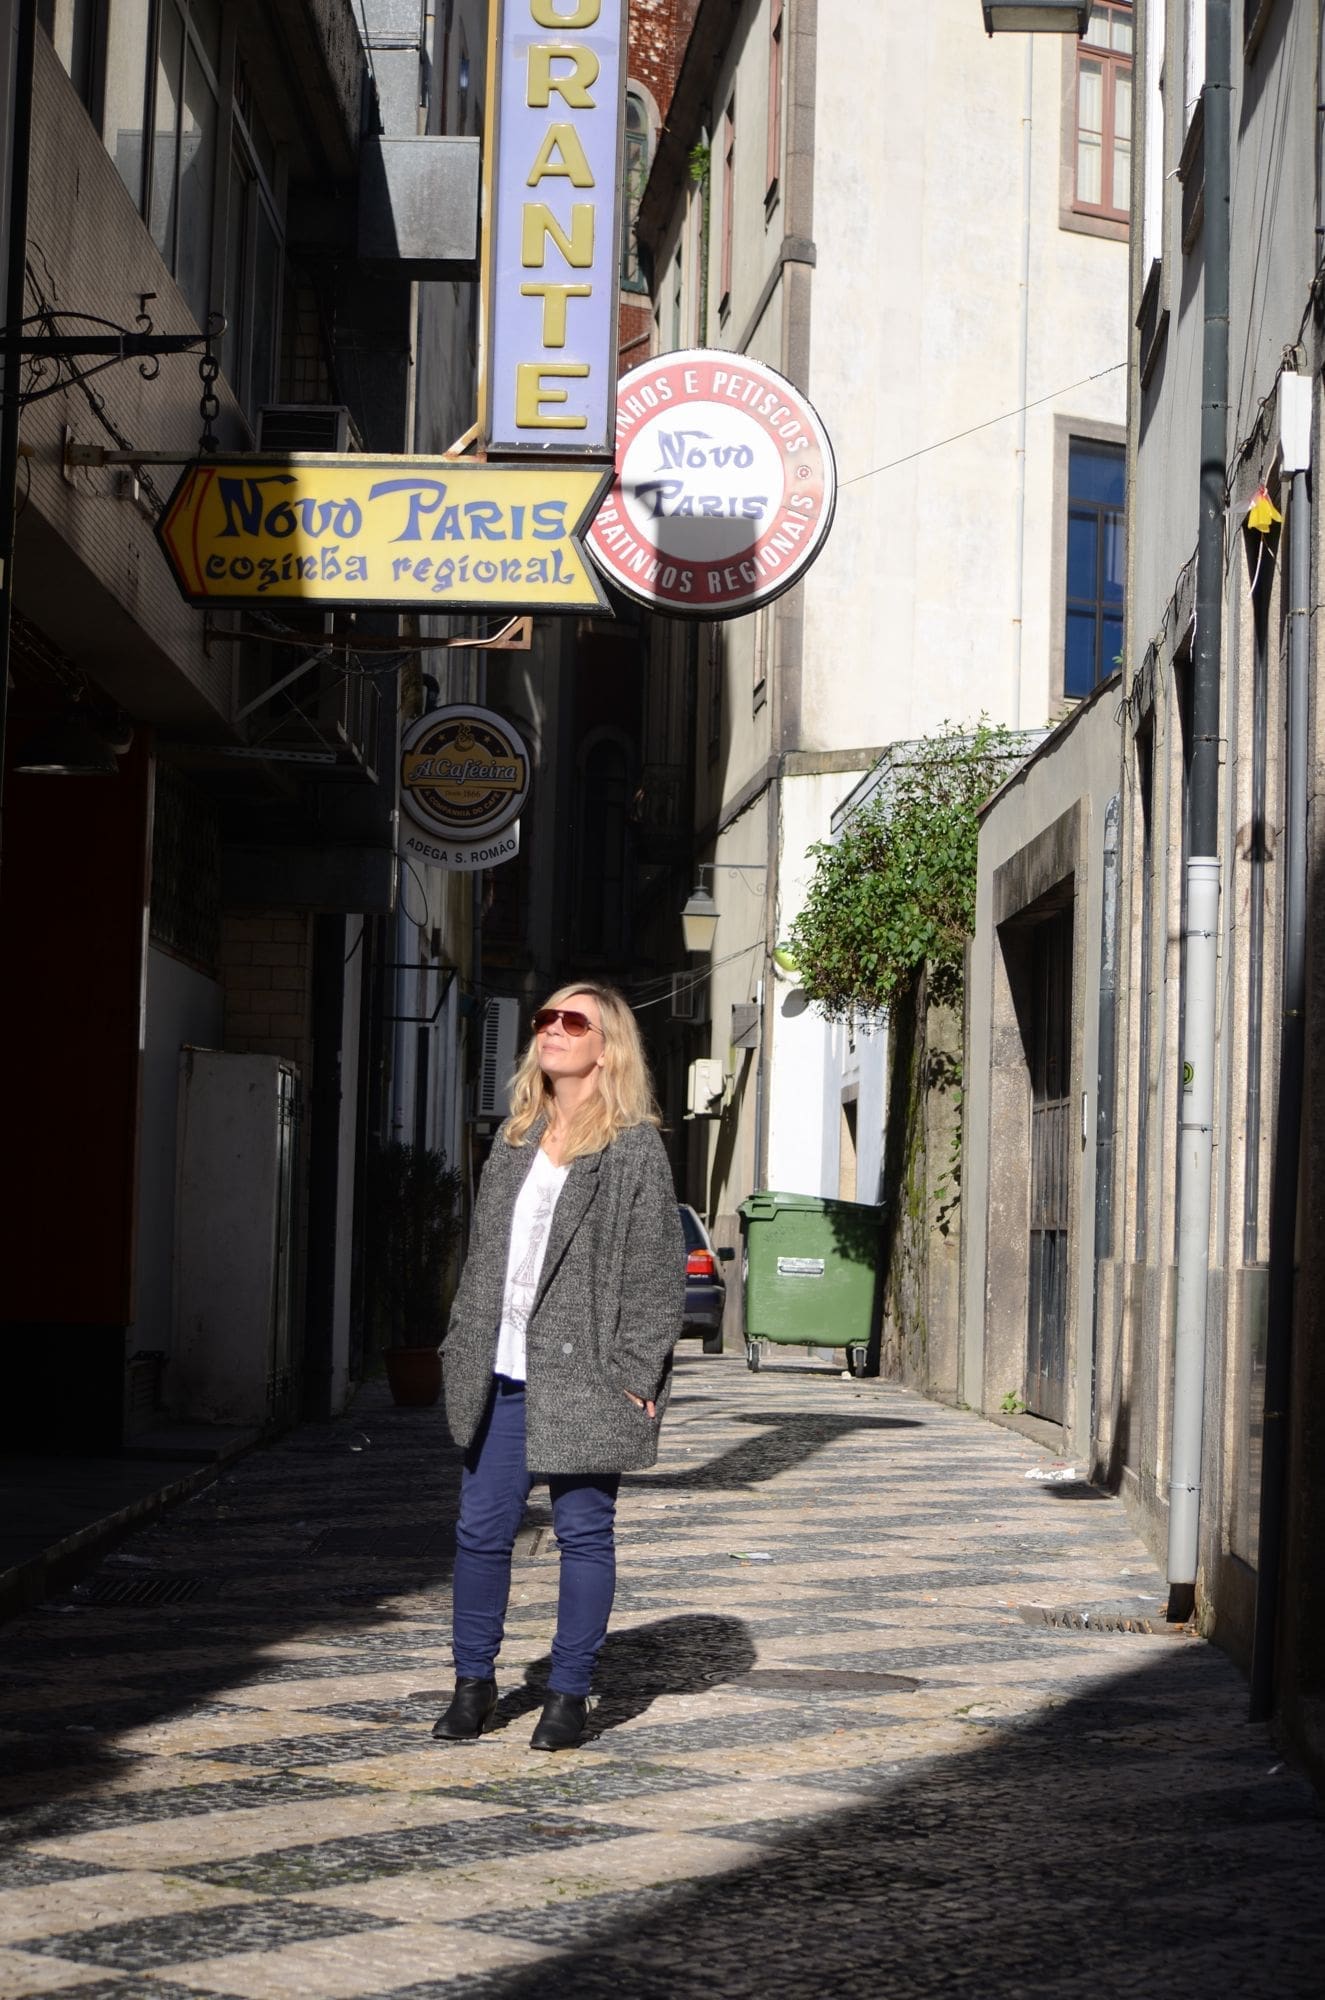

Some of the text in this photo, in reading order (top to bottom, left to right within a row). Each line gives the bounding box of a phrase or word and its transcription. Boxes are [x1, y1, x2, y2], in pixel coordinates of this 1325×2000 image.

[684, 370, 699, 394] E
[712, 370, 809, 453] PETISCOS
[707, 494, 814, 595] REGIONAIS
[205, 547, 575, 593] cozinha regional
[409, 758, 435, 782] A
[430, 796, 471, 817] COMPANHIA
[472, 807, 484, 817] DO
[406, 837, 516, 863] ADEGA S. ROMÃO
